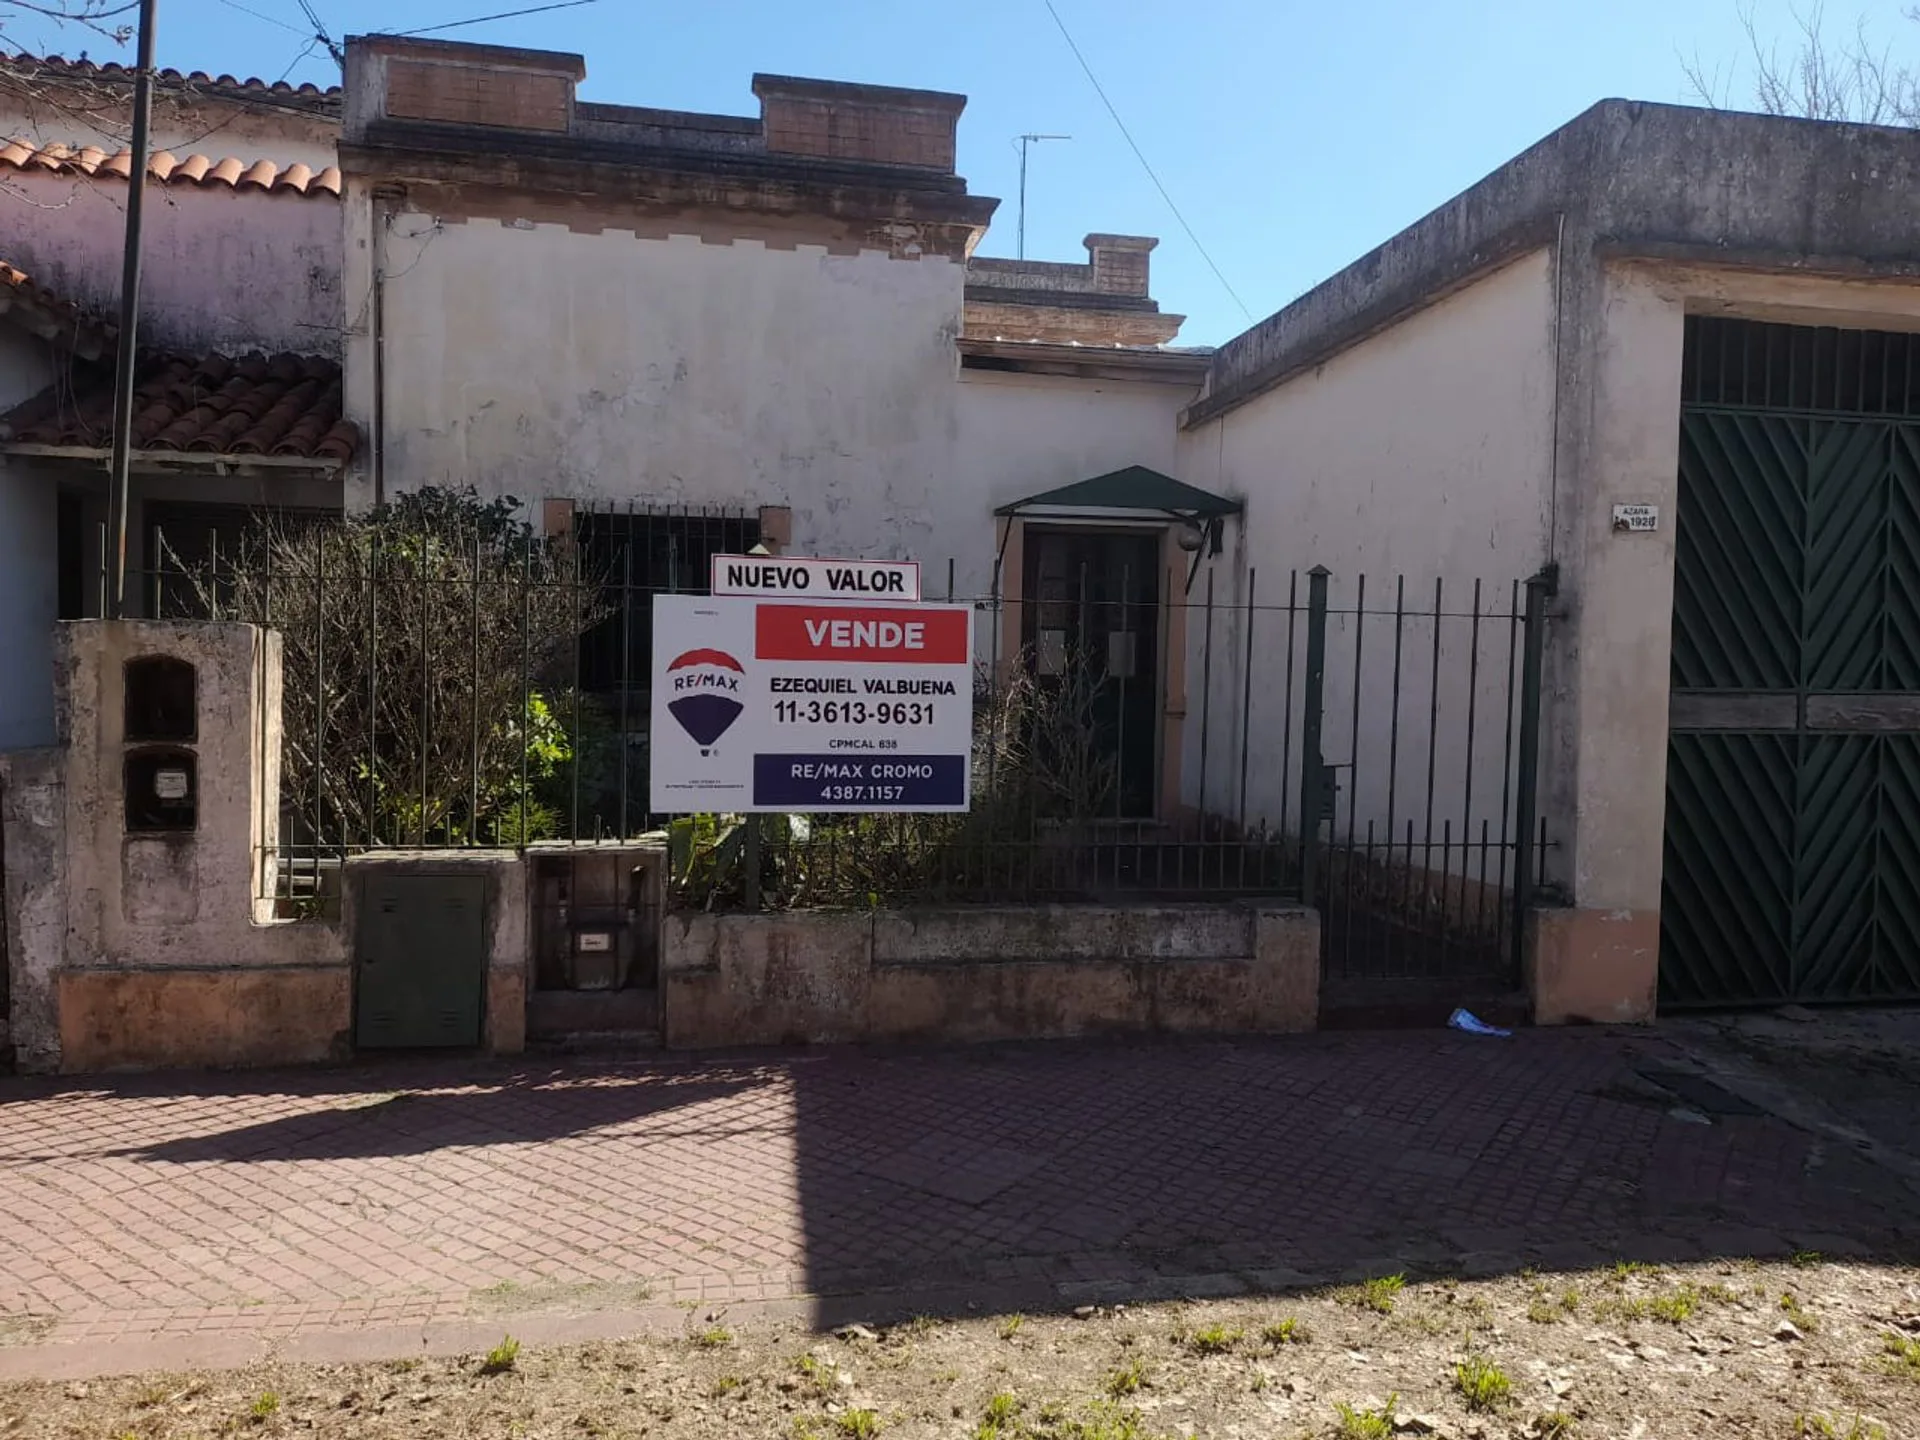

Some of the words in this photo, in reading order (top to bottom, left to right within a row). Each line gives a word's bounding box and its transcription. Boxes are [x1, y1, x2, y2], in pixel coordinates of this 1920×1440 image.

[727, 565, 810, 590] NUEVO
[826, 569, 904, 592] VALOR
[804, 619, 926, 649] VENDE
[674, 673, 739, 693] RE/MAX
[770, 677, 857, 693] EZEQUIEL
[863, 679, 956, 696] VALBUENA
[774, 700, 935, 725] 11-3613-9631
[829, 739, 875, 749] CPMCAL
[791, 764, 864, 780] RE/MAX
[871, 765, 934, 779] CROMO
[820, 786, 904, 801] 4387.1157
